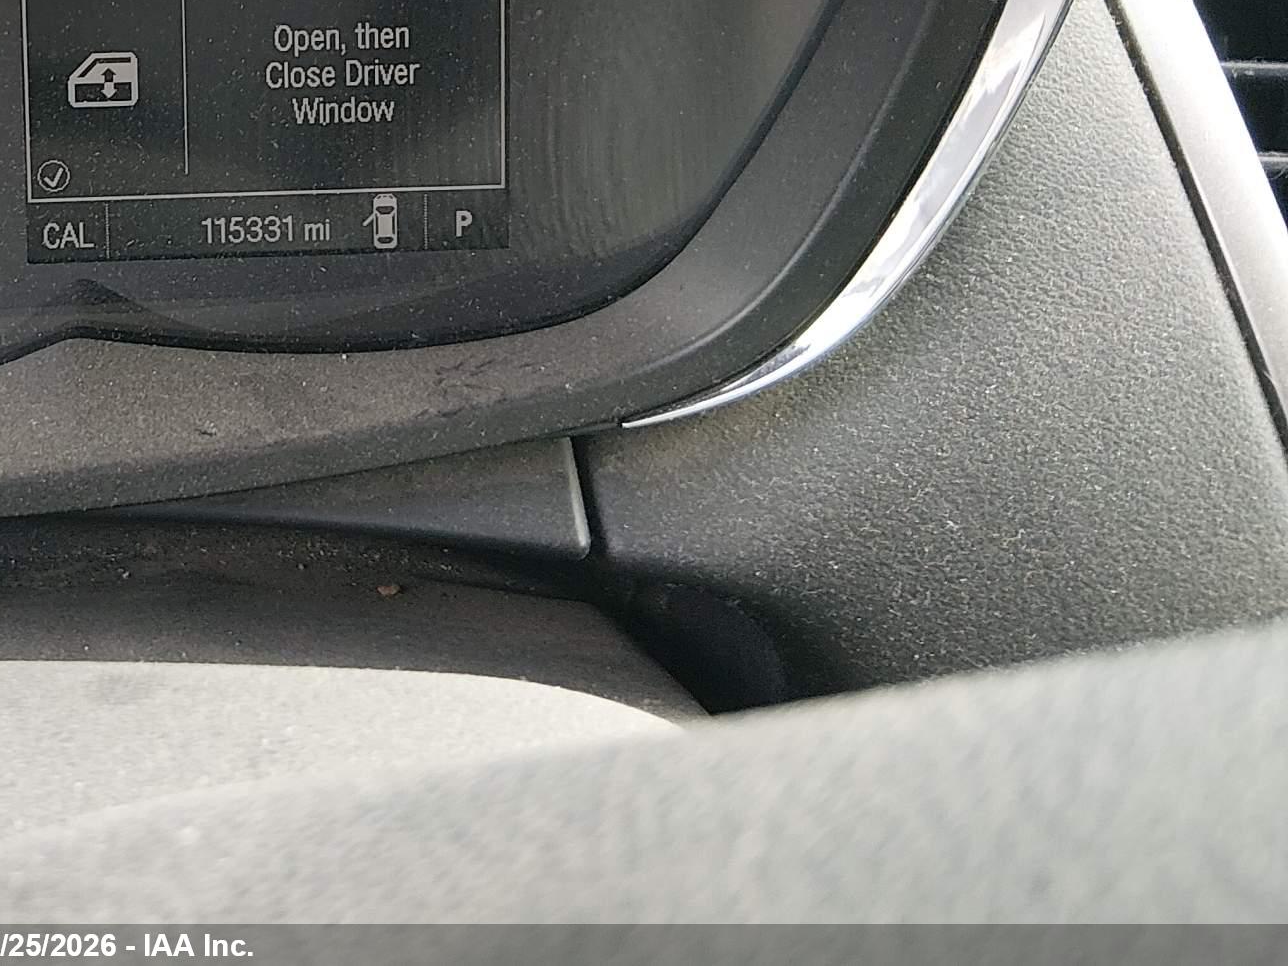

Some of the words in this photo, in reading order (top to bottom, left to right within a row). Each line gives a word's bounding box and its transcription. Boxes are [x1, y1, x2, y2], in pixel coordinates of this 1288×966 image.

[273, 23, 347, 55] Open,
[355, 22, 410, 49] then
[265, 61, 335, 88] Close
[346, 59, 420, 86] Driver
[292, 98, 394, 124] Window
[43, 222, 94, 250] CAL
[202, 215, 293, 244] 115331
[305, 214, 331, 241] mi
[455, 211, 473, 237] P
